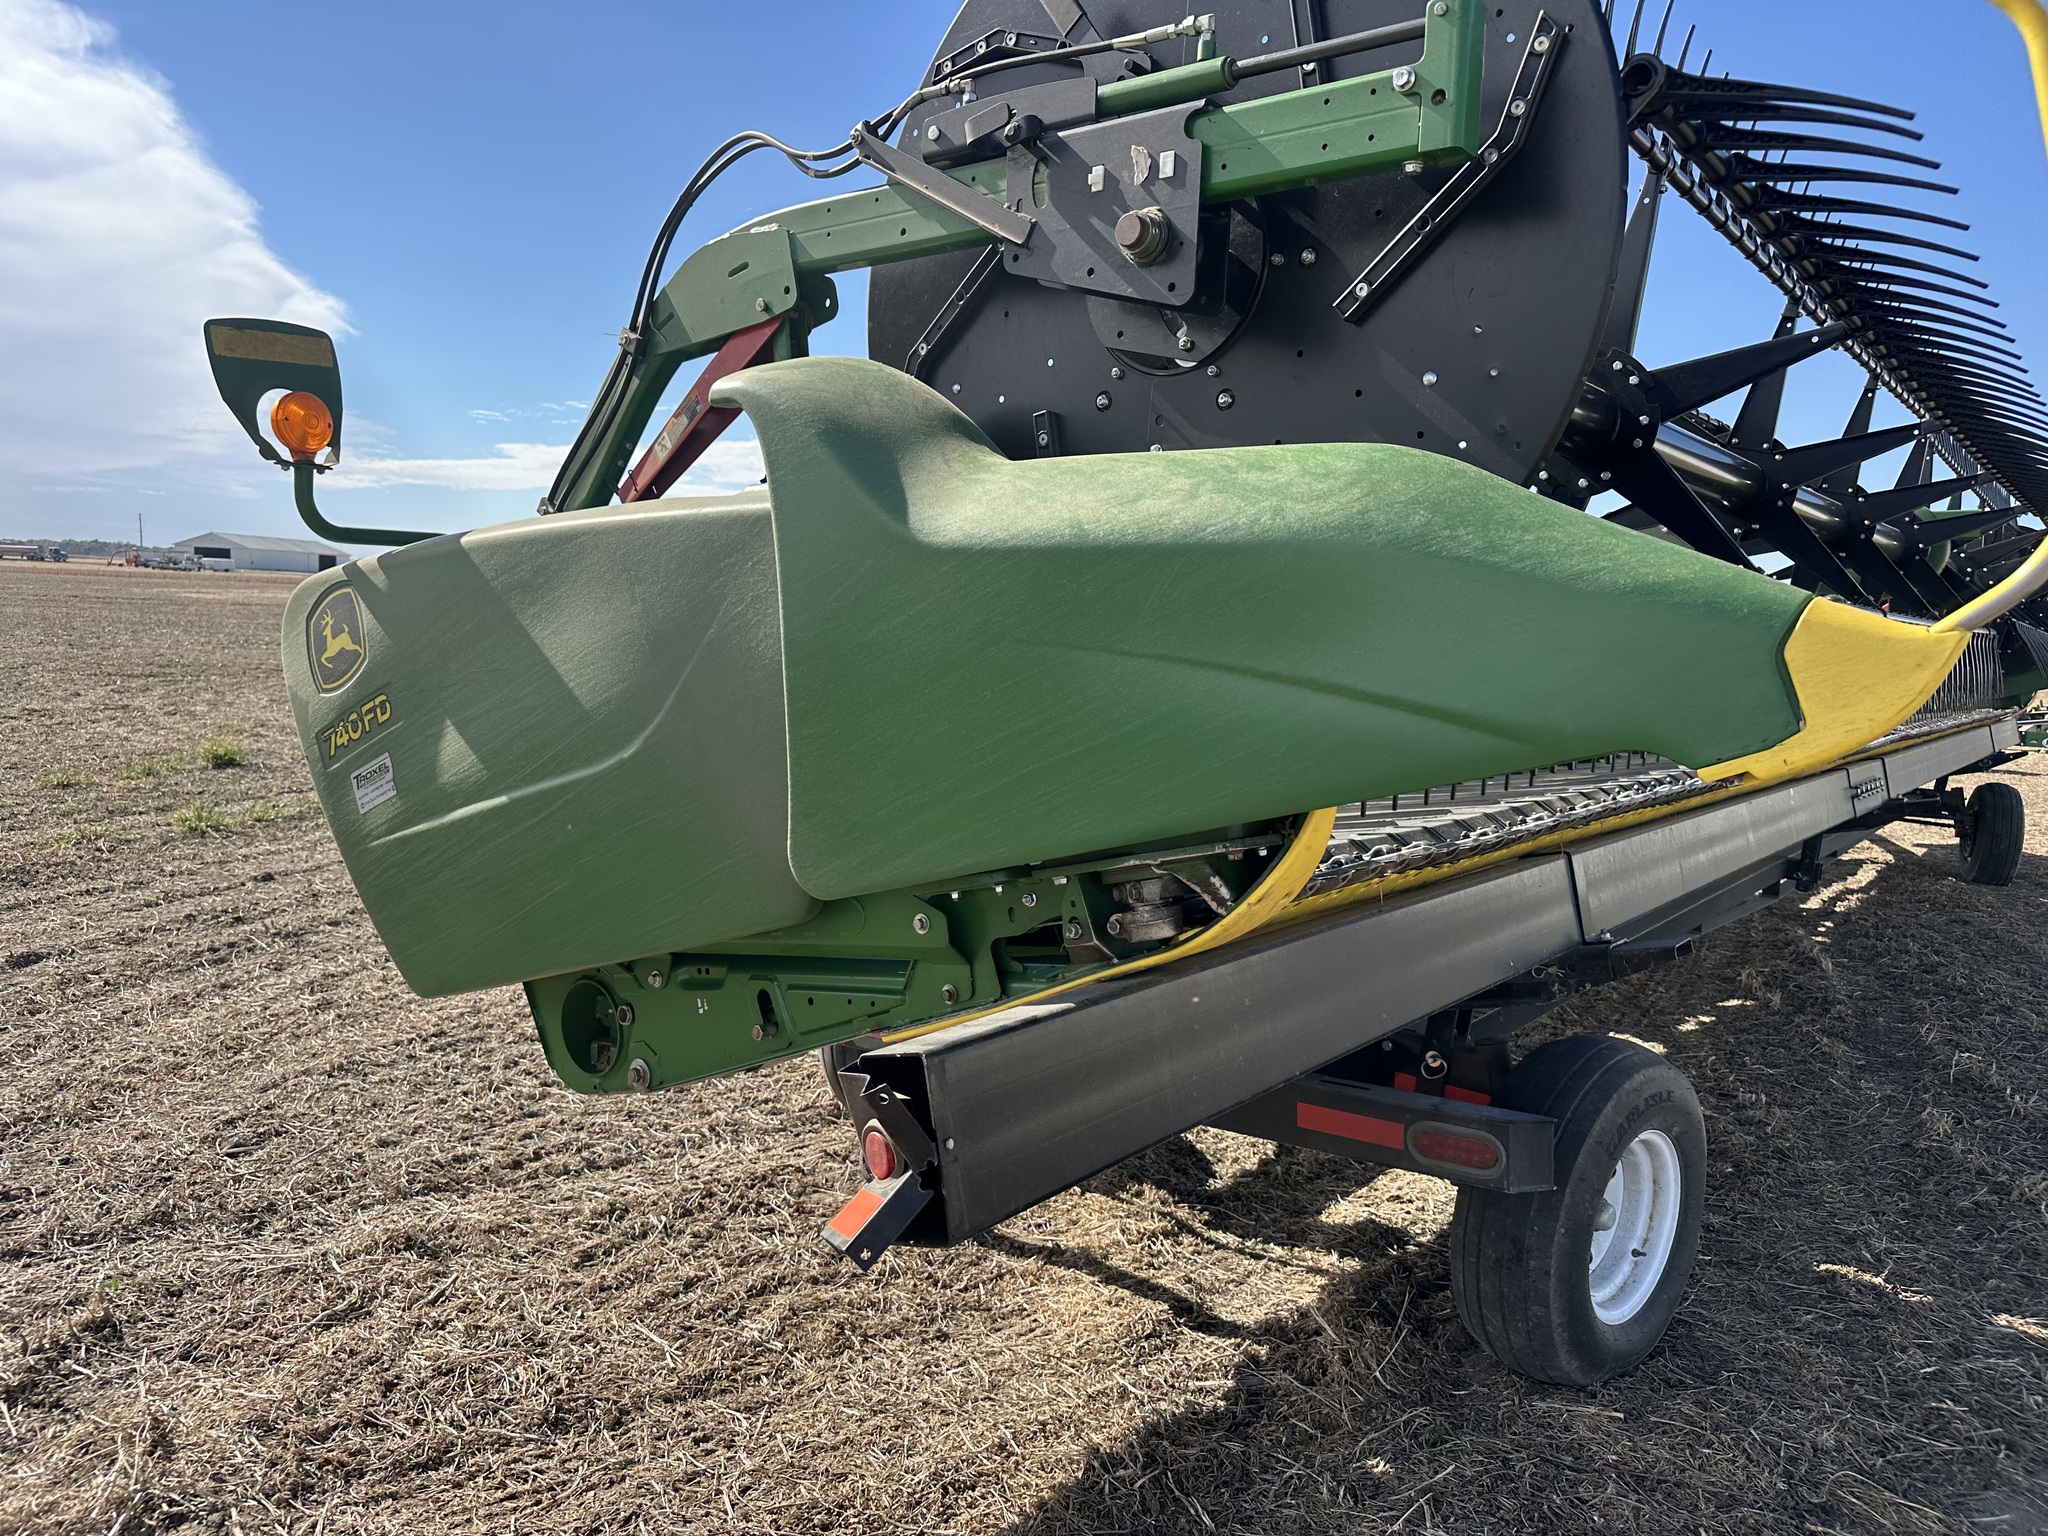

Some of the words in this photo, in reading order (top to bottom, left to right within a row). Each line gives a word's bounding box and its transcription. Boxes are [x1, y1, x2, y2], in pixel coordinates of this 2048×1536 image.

[323, 694, 391, 758] 740FD
[353, 762, 390, 790] TROXEL
[1606, 1090, 1674, 1160] CARLISLE
